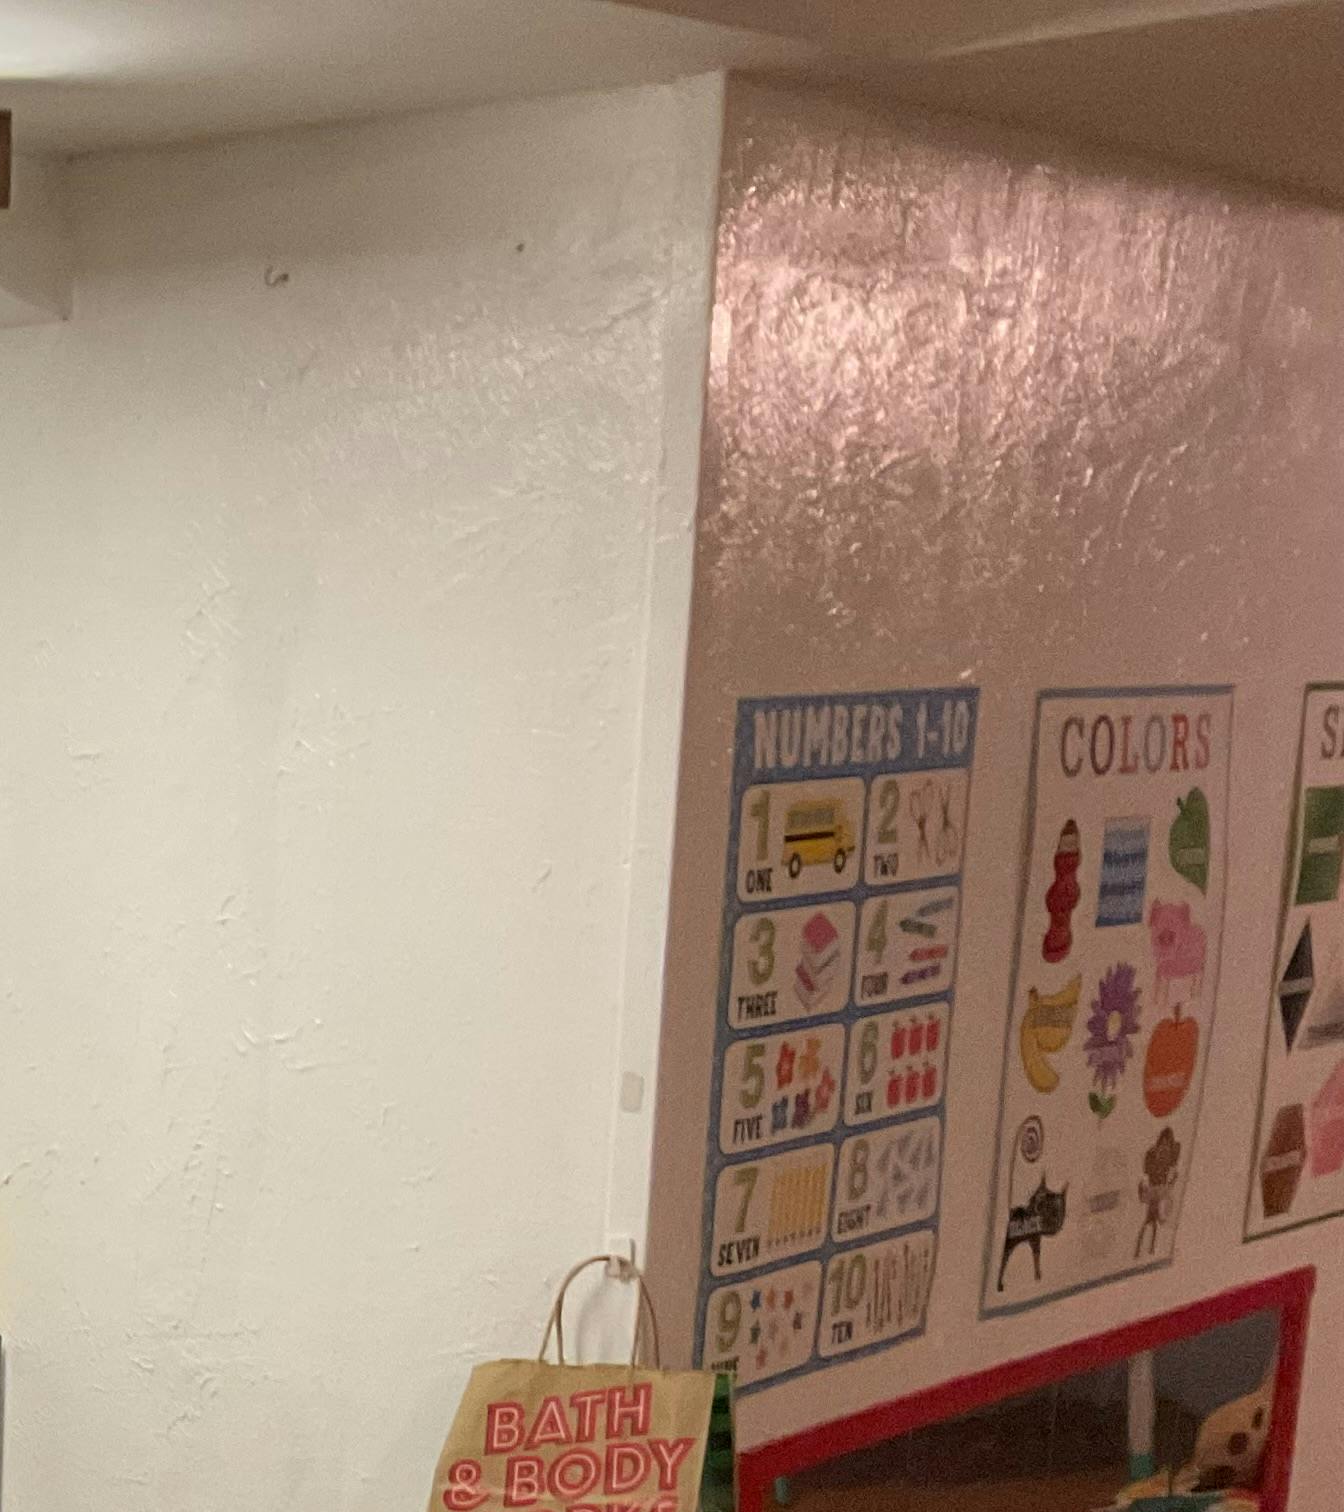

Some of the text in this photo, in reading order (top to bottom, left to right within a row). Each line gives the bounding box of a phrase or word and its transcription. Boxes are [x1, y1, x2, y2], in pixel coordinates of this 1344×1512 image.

[753, 699, 970, 770] NUMBERS 1-10
[1060, 713, 1213, 777] COLORS
[751, 789, 771, 861] 1
[877, 779, 900, 844] 2
[745, 867, 774, 894] ONE
[872, 852, 900, 878] TWO
[747, 917, 776, 986] 3
[865, 898, 889, 964] 4
[739, 1042, 767, 1109] 5
[859, 1020, 880, 1085] 6
[732, 1114, 764, 1144] FIVE
[733, 1166, 760, 1233] 7
[848, 1138, 870, 1201] 8
[717, 1236, 761, 1267] SEVEN
[828, 1253, 867, 1317] 10
[716, 1290, 742, 1353] 9
[831, 1320, 854, 1345] TEN
[485, 1382, 654, 1457] BATH
[442, 1436, 699, 1512] & BODY
